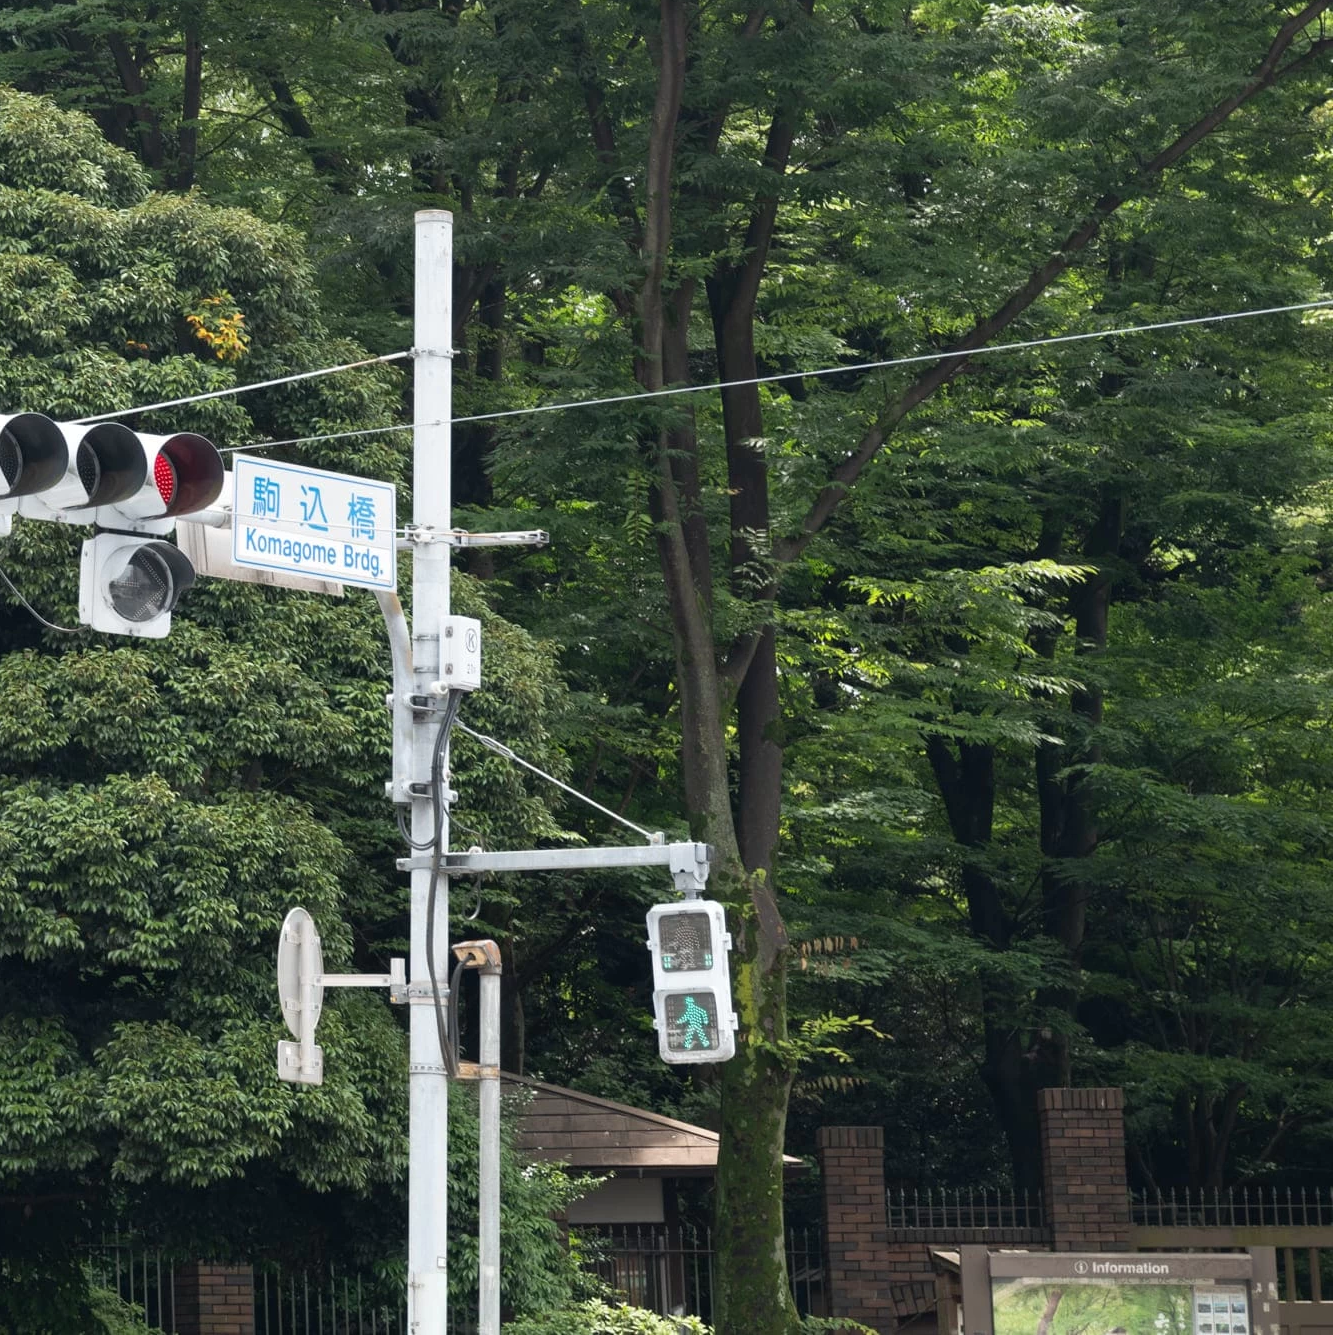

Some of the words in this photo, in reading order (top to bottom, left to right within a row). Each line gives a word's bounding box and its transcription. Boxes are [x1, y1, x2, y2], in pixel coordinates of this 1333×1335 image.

[252, 476, 376, 541] 駒込橋
[245, 527, 336, 564] Komagome
[344, 544, 384, 578] Brdg.
[1092, 1262, 1169, 1275] Information
